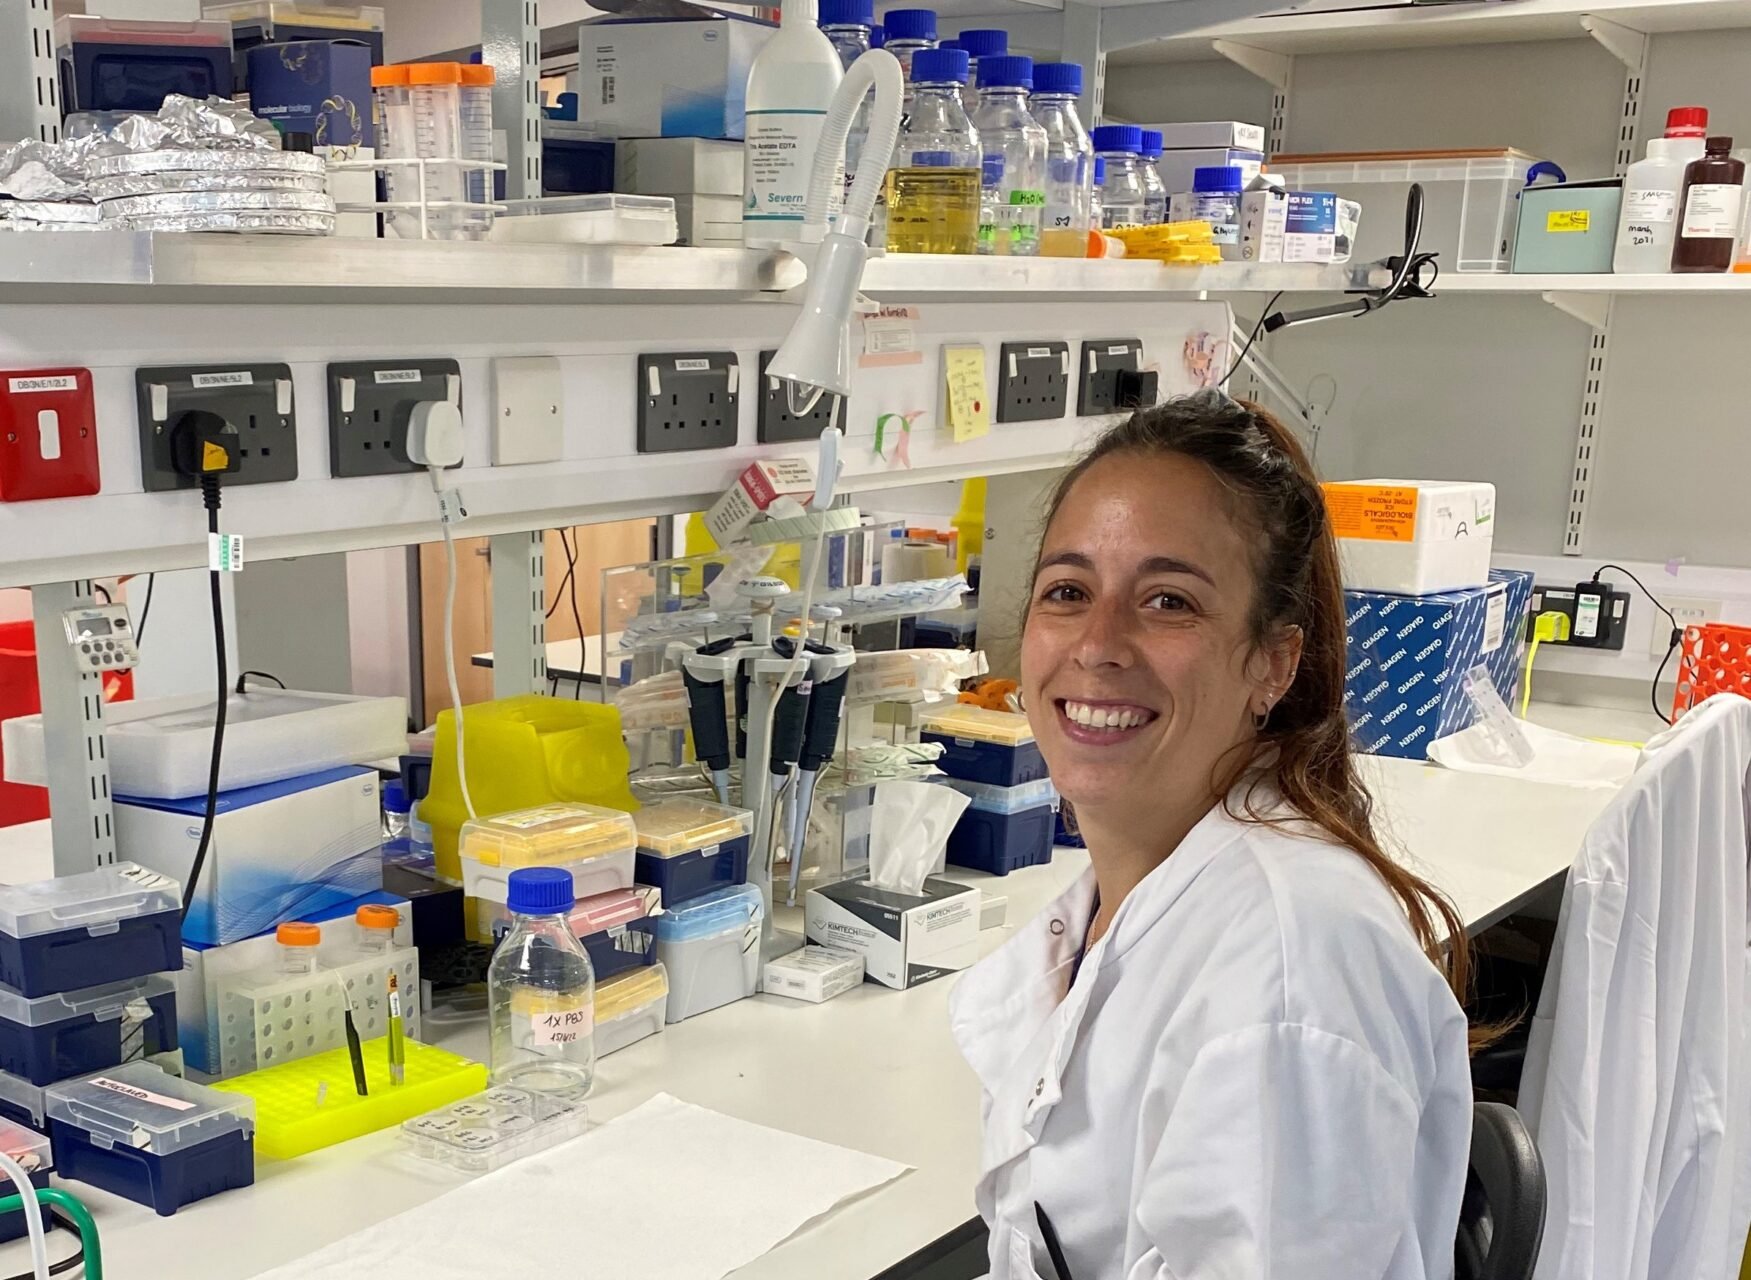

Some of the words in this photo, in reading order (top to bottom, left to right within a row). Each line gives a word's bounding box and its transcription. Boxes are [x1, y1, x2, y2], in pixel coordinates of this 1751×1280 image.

[778, 142, 797, 150] EDTA
[768, 192, 803, 203] Severn
[1364, 510, 1413, 519] BIOLOGICALS
[1345, 603, 1372, 627] QIAGEN
[1362, 625, 1389, 649] QIAGEN
[1396, 616, 1424, 640] QIAGEN
[1380, 647, 1407, 671] QIAGEN
[1414, 638, 1442, 662] QIAGEN
[1345, 658, 1371, 681] QIAGEN
[1363, 681, 1389, 703] QIAGEN
[1397, 671, 1425, 694] QIAGEN
[1381, 702, 1408, 725] QIAGEN
[1416, 693, 1442, 716] QIAGEN
[1398, 725, 1426, 748] QIAGEN
[926, 909, 951, 922] KIMTECH
[827, 921, 859, 936] KIMTECH
[565, 1011, 584, 1025] PBS
